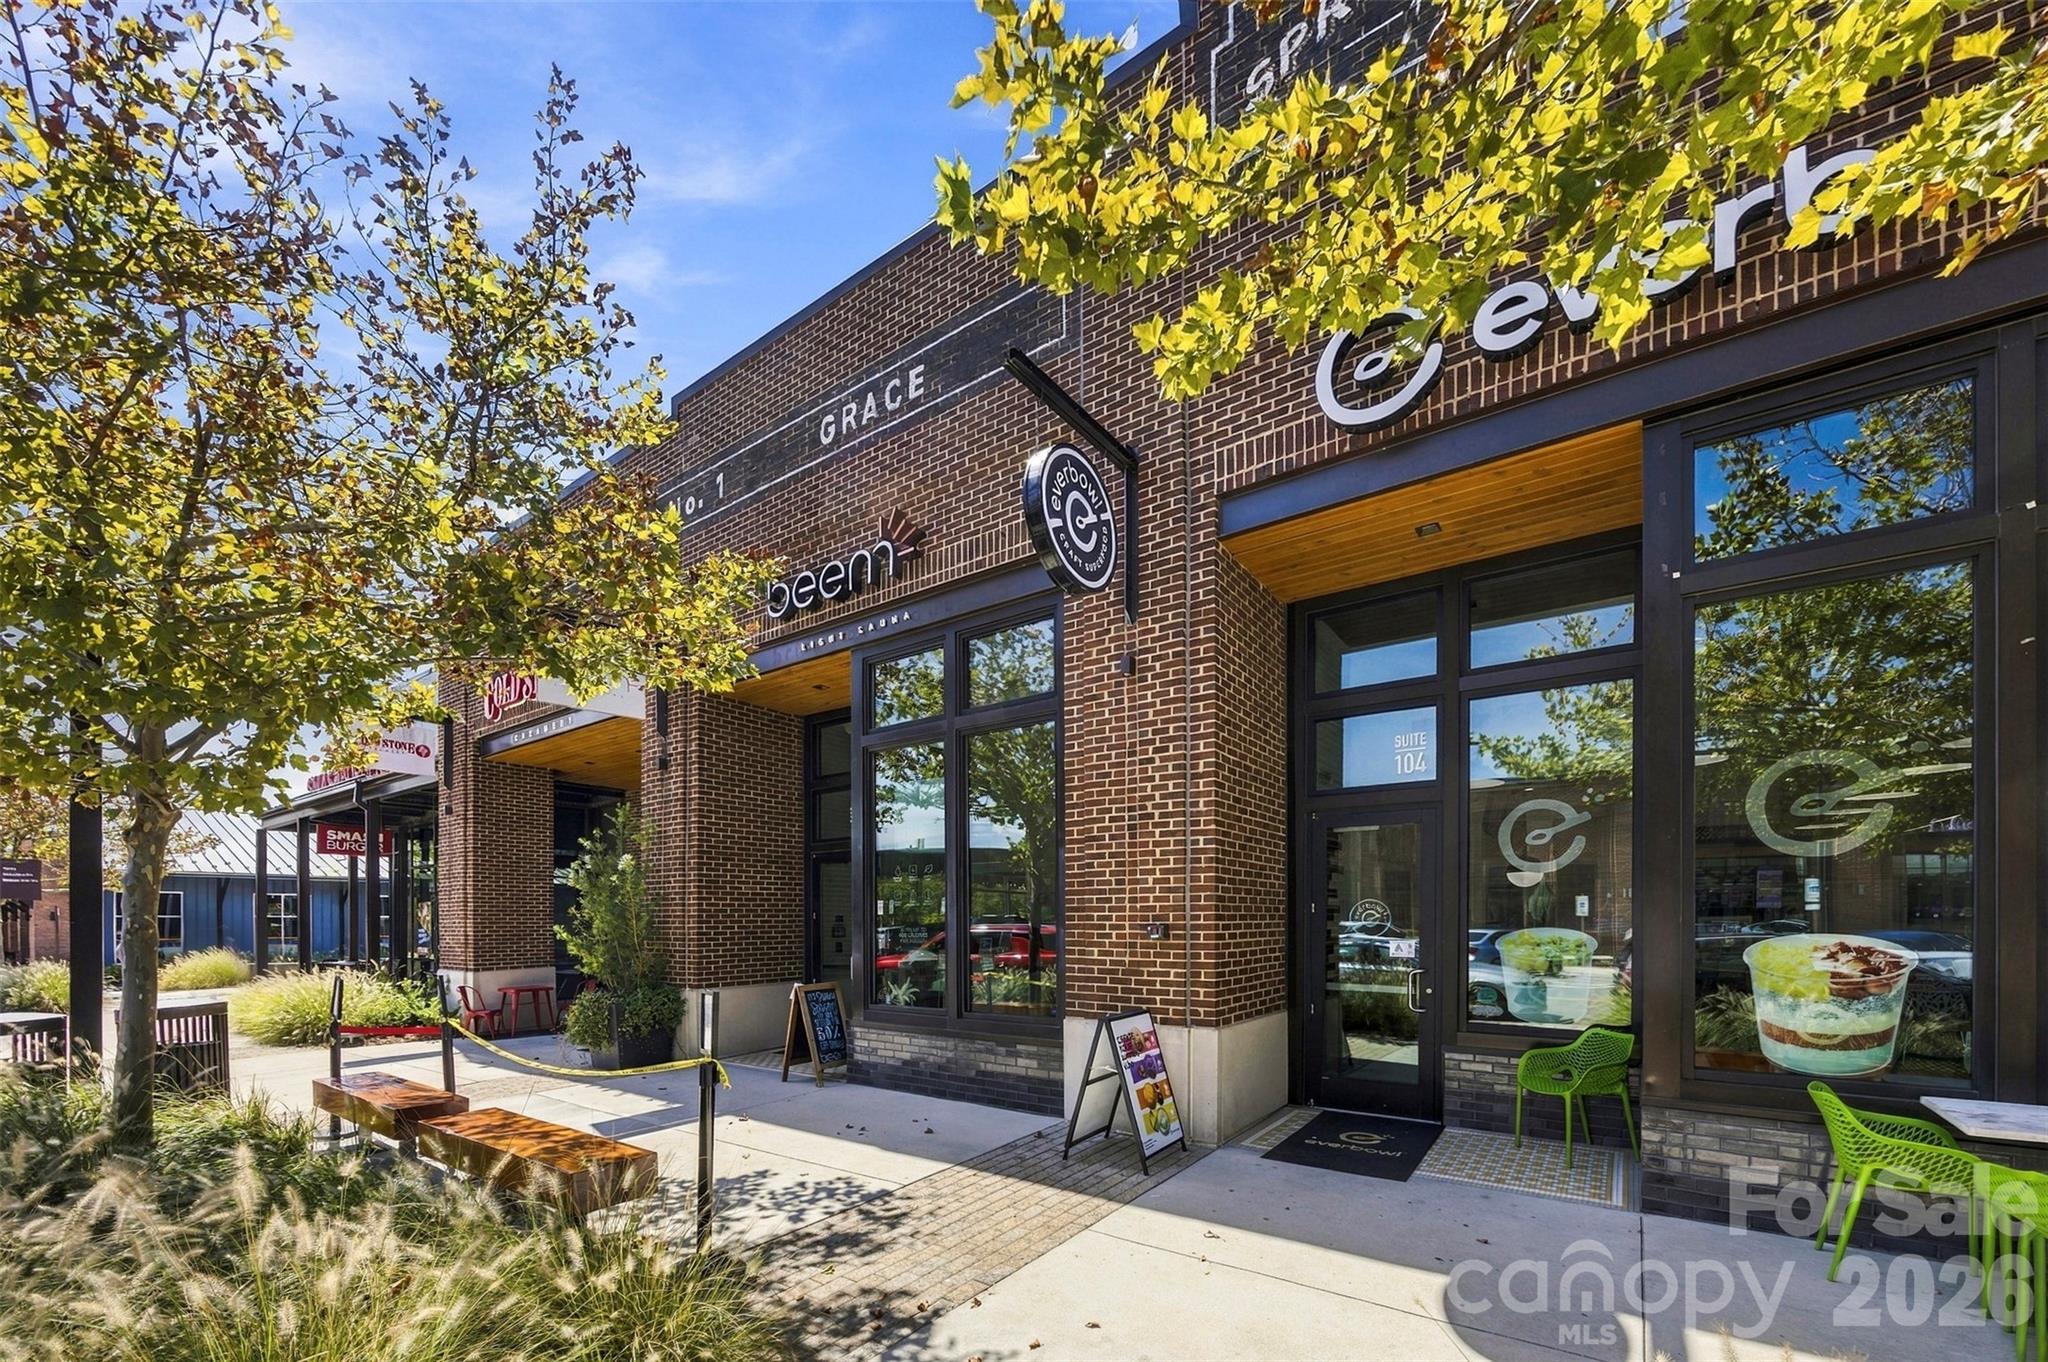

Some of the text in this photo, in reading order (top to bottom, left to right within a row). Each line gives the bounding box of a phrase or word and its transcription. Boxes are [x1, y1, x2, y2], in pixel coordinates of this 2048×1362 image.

[715, 472, 724, 499] 1
[819, 364, 925, 445] GRACE
[1051, 459, 1103, 512] everbowl
[1059, 526, 1109, 572] CRAFT SUPERFOOD
[767, 540, 894, 618] beem
[800, 611, 912, 652] LIGHT SAUNA
[382, 738, 415, 755] STONE
[1394, 732, 1427, 748] SUITE
[1394, 751, 1428, 775] 104
[327, 829, 384, 843] SMA
[327, 840, 384, 853] BURG
[1304, 1138, 1402, 1157] everbowl
